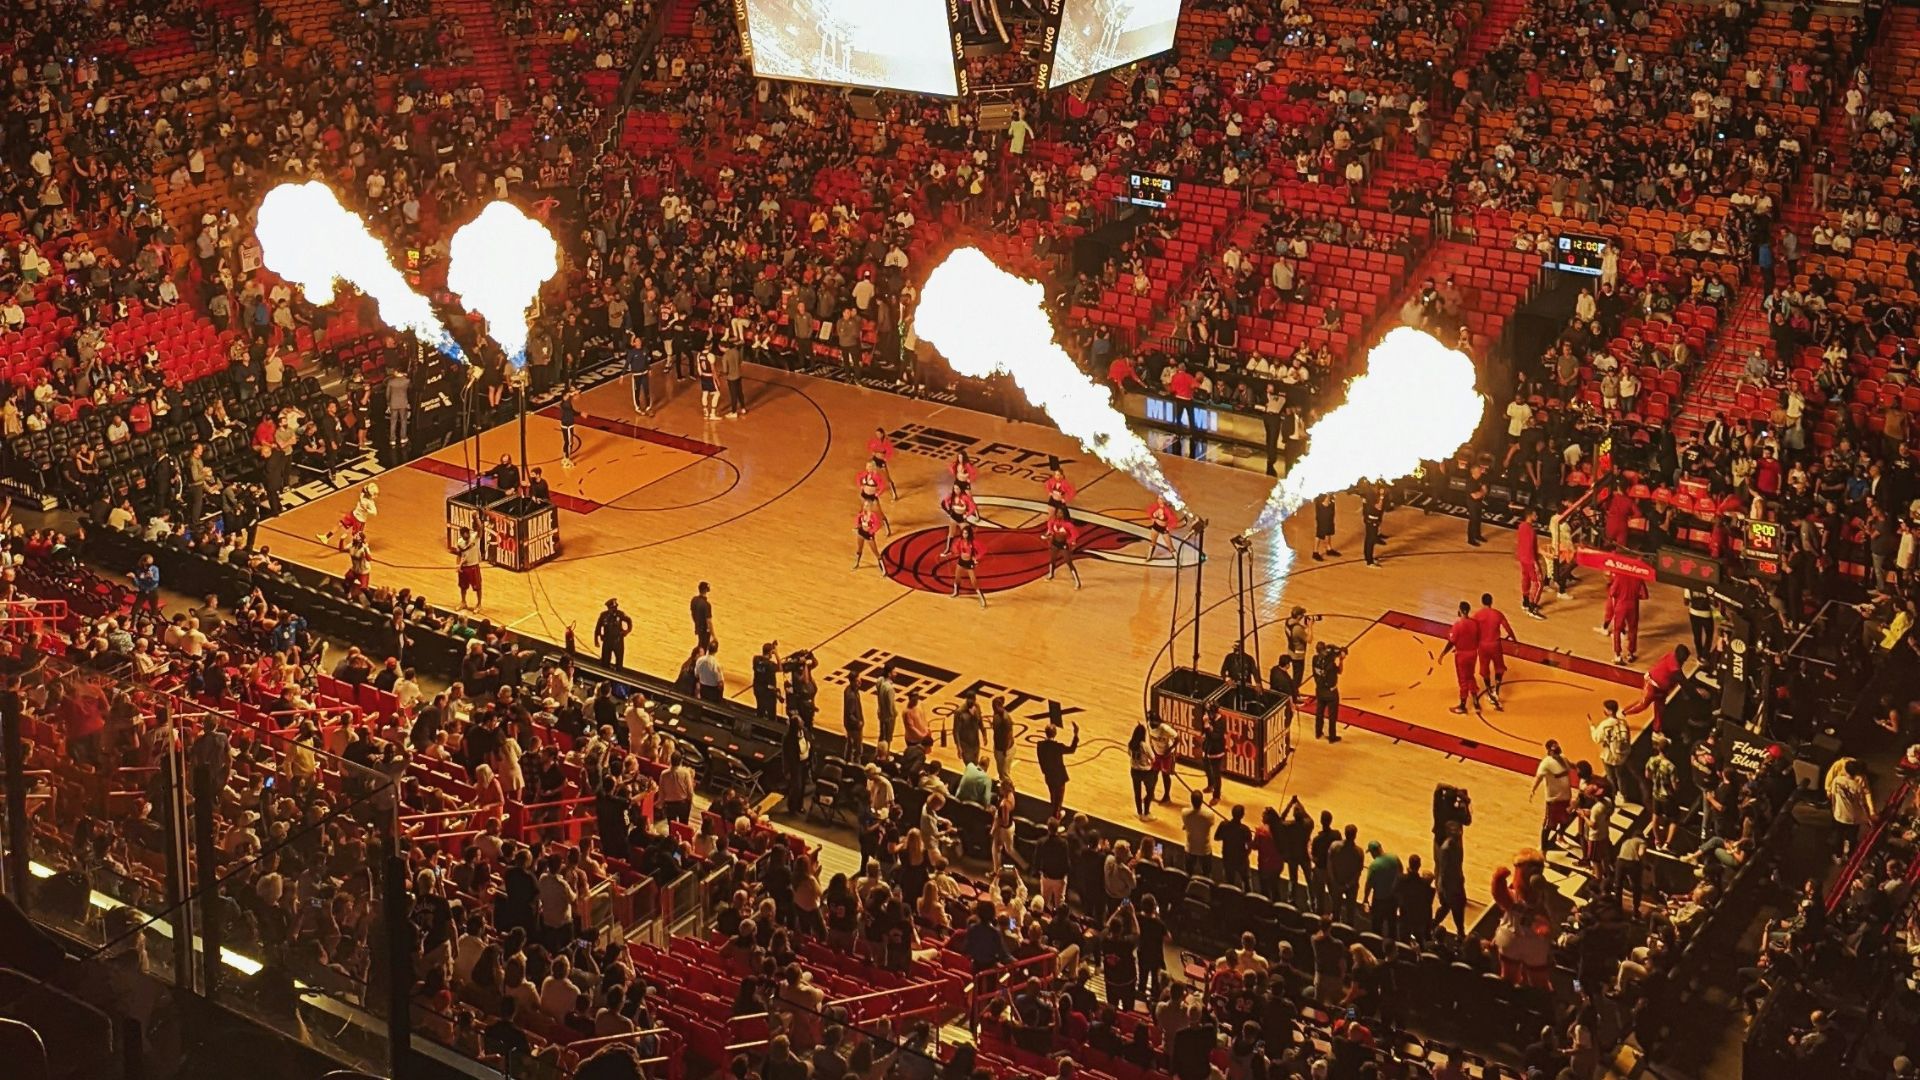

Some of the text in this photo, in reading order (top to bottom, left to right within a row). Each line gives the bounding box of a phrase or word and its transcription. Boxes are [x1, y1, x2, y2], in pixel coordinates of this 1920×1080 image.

[741, 31, 752, 56] UKG
[954, 32, 965, 60] UKG
[1043, 26, 1056, 53] UKG
[959, 69, 969, 97] UKG
[1036, 63, 1049, 90] UKG
[1573, 239, 1598, 252] 12:00
[976, 442, 1078, 471] FTX
[528, 510, 554, 542] MAKE
[528, 531, 555, 565] NOISE
[1753, 534, 1772, 548] 24
[1732, 653, 1744, 682] AT&T
[955, 679, 1087, 729] FTX
[1158, 695, 1196, 730] MAKE
[1225, 713, 1255, 740] LET'S
[1225, 752, 1256, 778] HEAT!
[1730, 753, 1760, 770] Blue
